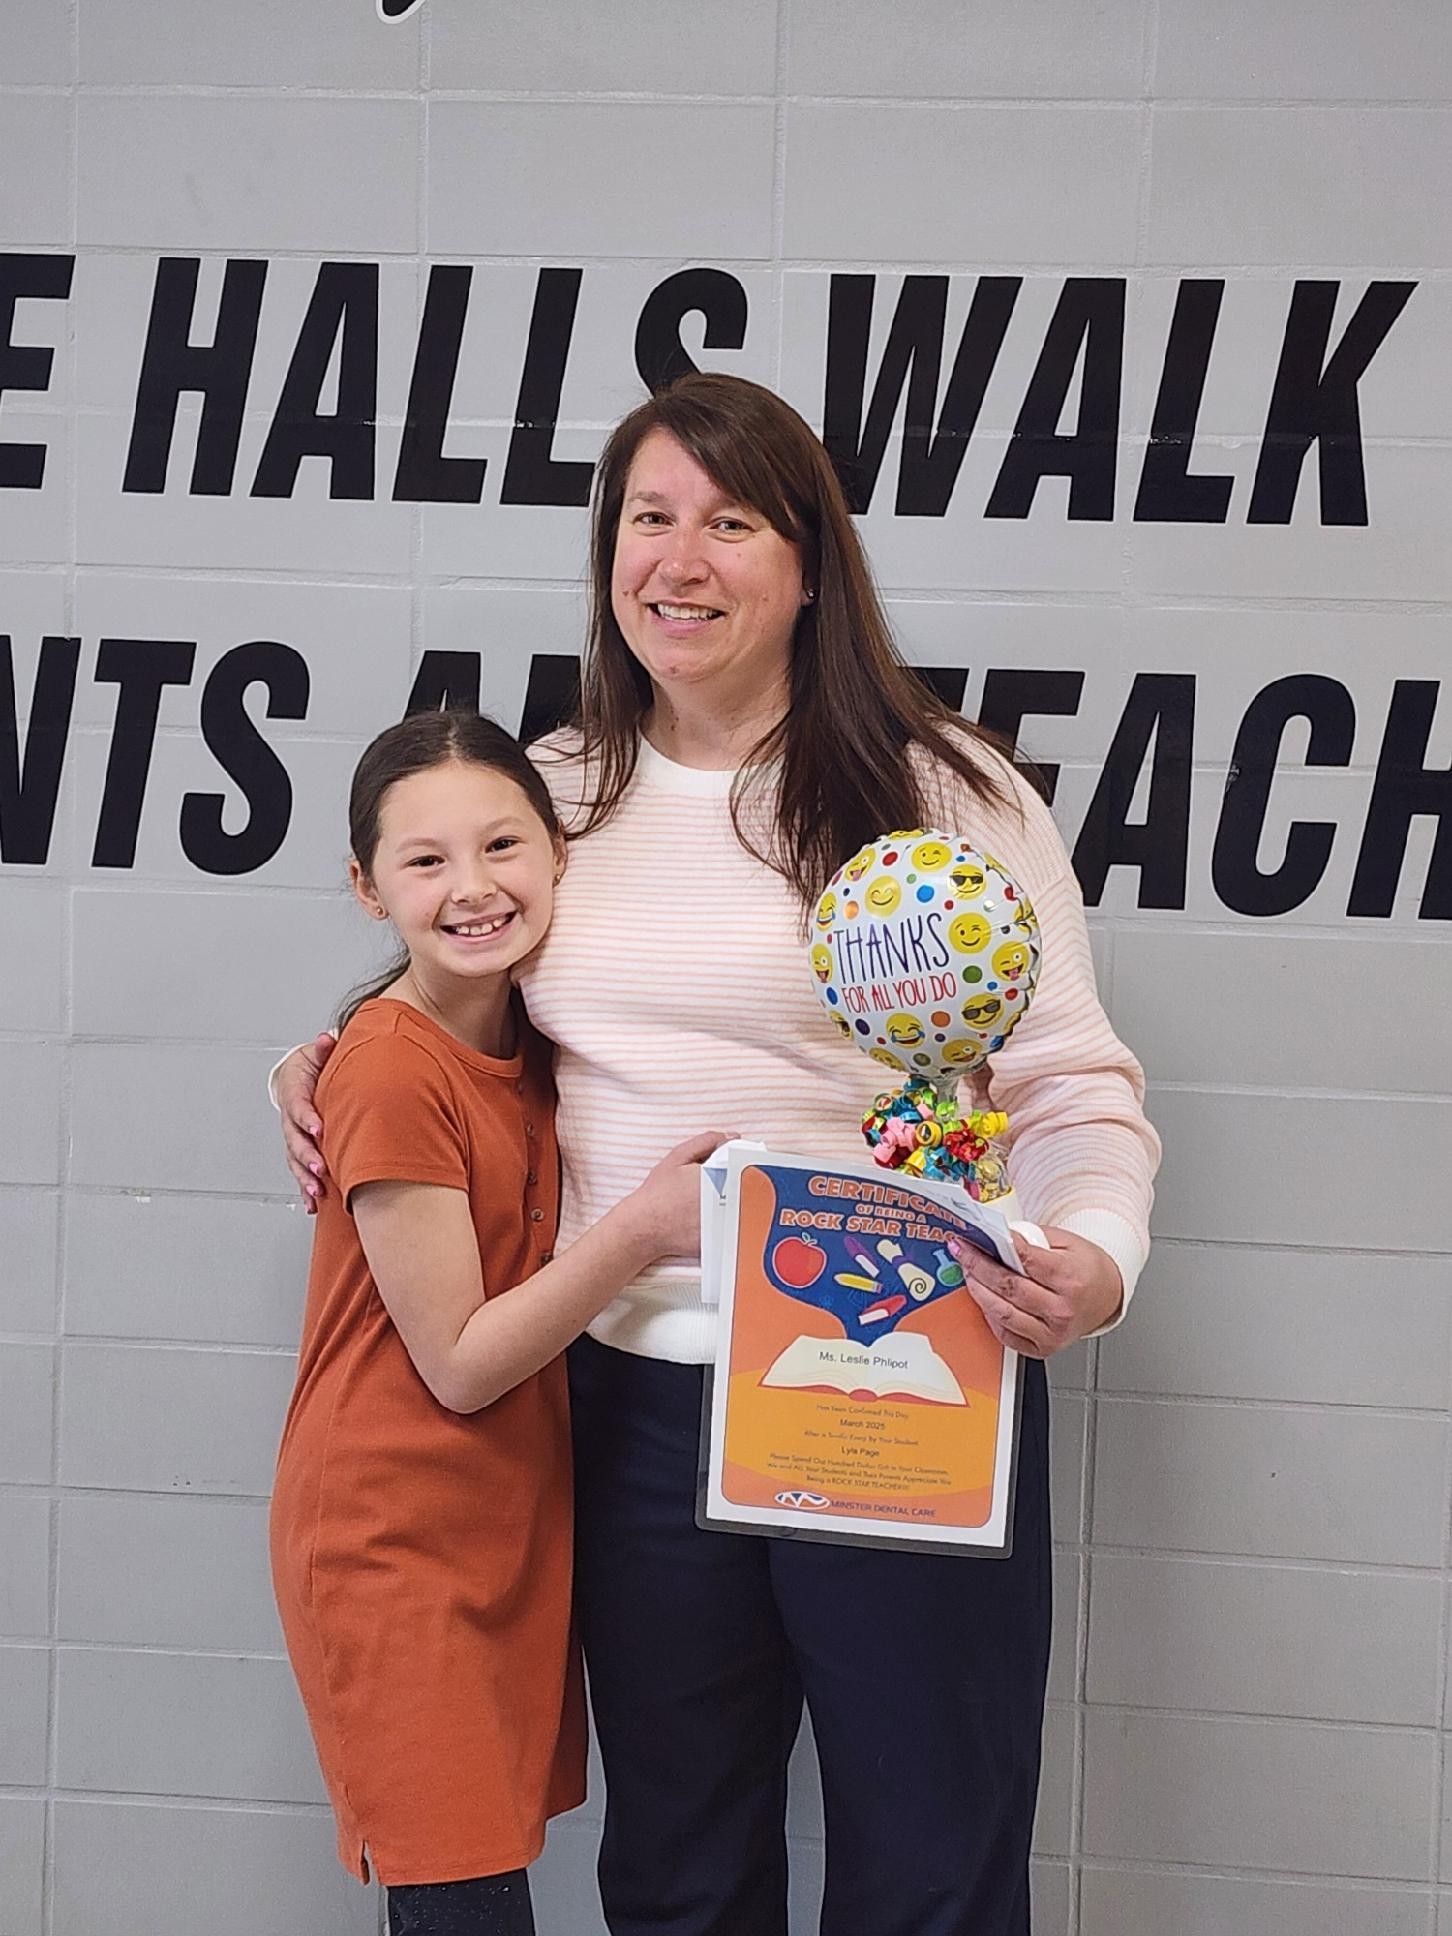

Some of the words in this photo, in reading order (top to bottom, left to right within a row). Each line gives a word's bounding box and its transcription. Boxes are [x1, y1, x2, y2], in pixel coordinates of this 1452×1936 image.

[823, 271, 1420, 527] WALK
[833, 912, 950, 984] THANKS
[841, 985, 871, 1013] FOR
[871, 984, 895, 1012] ALL
[892, 978, 927, 1009] YOU
[929, 971, 957, 1002] DO
[780, 1208, 844, 1230] ROCK
[845, 1215, 902, 1237] STAR
[855, 1203, 874, 1215] OF
[915, 1213, 927, 1224] A
[819, 1351, 837, 1362] Ms.
[840, 1353, 870, 1365] Leslie
[840, 1419, 863, 1428] March
[874, 1504, 910, 1516] DENTAL
[911, 1508, 937, 1518] CARE
